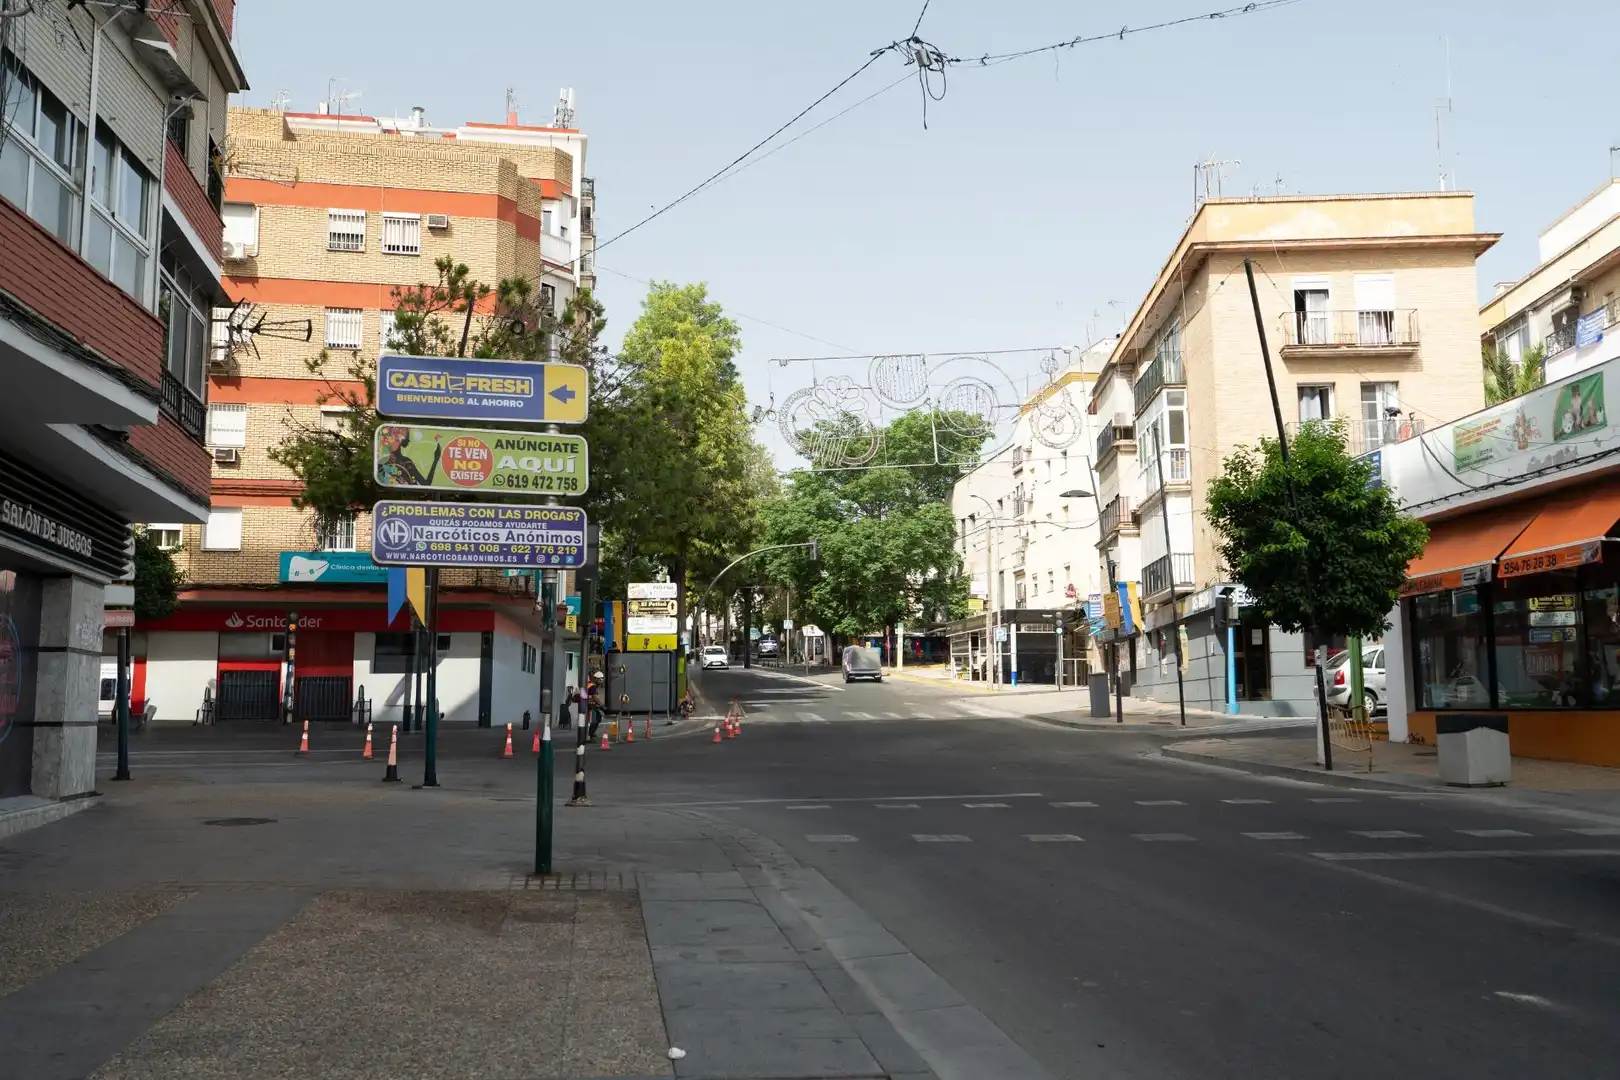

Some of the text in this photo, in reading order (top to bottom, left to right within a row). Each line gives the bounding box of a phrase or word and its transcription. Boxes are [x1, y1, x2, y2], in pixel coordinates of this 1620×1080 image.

[390, 372, 530, 394] CASH FRESH
[397, 394, 524, 408] BIENVENIDOS AL AHORRO
[449, 447, 488, 460] TE VEN
[495, 438, 579, 454] ANÚNCIATE
[453, 460, 481, 470] NO
[497, 455, 576, 474] AQUÍ
[450, 471, 484, 481] EXISTES
[507, 475, 578, 491] 619 472 758
[381, 505, 580, 521] ¿PROBLEMAS CON LAS DROGAS?
[2, 500, 92, 557] SALÓN DE JUEGOS
[429, 518, 460, 527] QUIZÁS
[462, 520, 503, 528] PODAMOS
[413, 527, 581, 544] Narcóticos Anónimos
[430, 543, 452, 551] 698
[455, 543, 475, 552] 941
[479, 544, 500, 553] 008
[511, 545, 530, 553] 622
[534, 546, 554, 554] 776
[558, 546, 577, 555] 219
[386, 552, 517, 563] WWW.NARCOTICOSANONIMOS.ES
[1504, 560, 1520, 574] 954
[1522, 558, 1531, 572] 76
[1532, 557, 1543, 569] 28
[1545, 554, 1557, 567] 38
[246, 615, 322, 628] Santader
